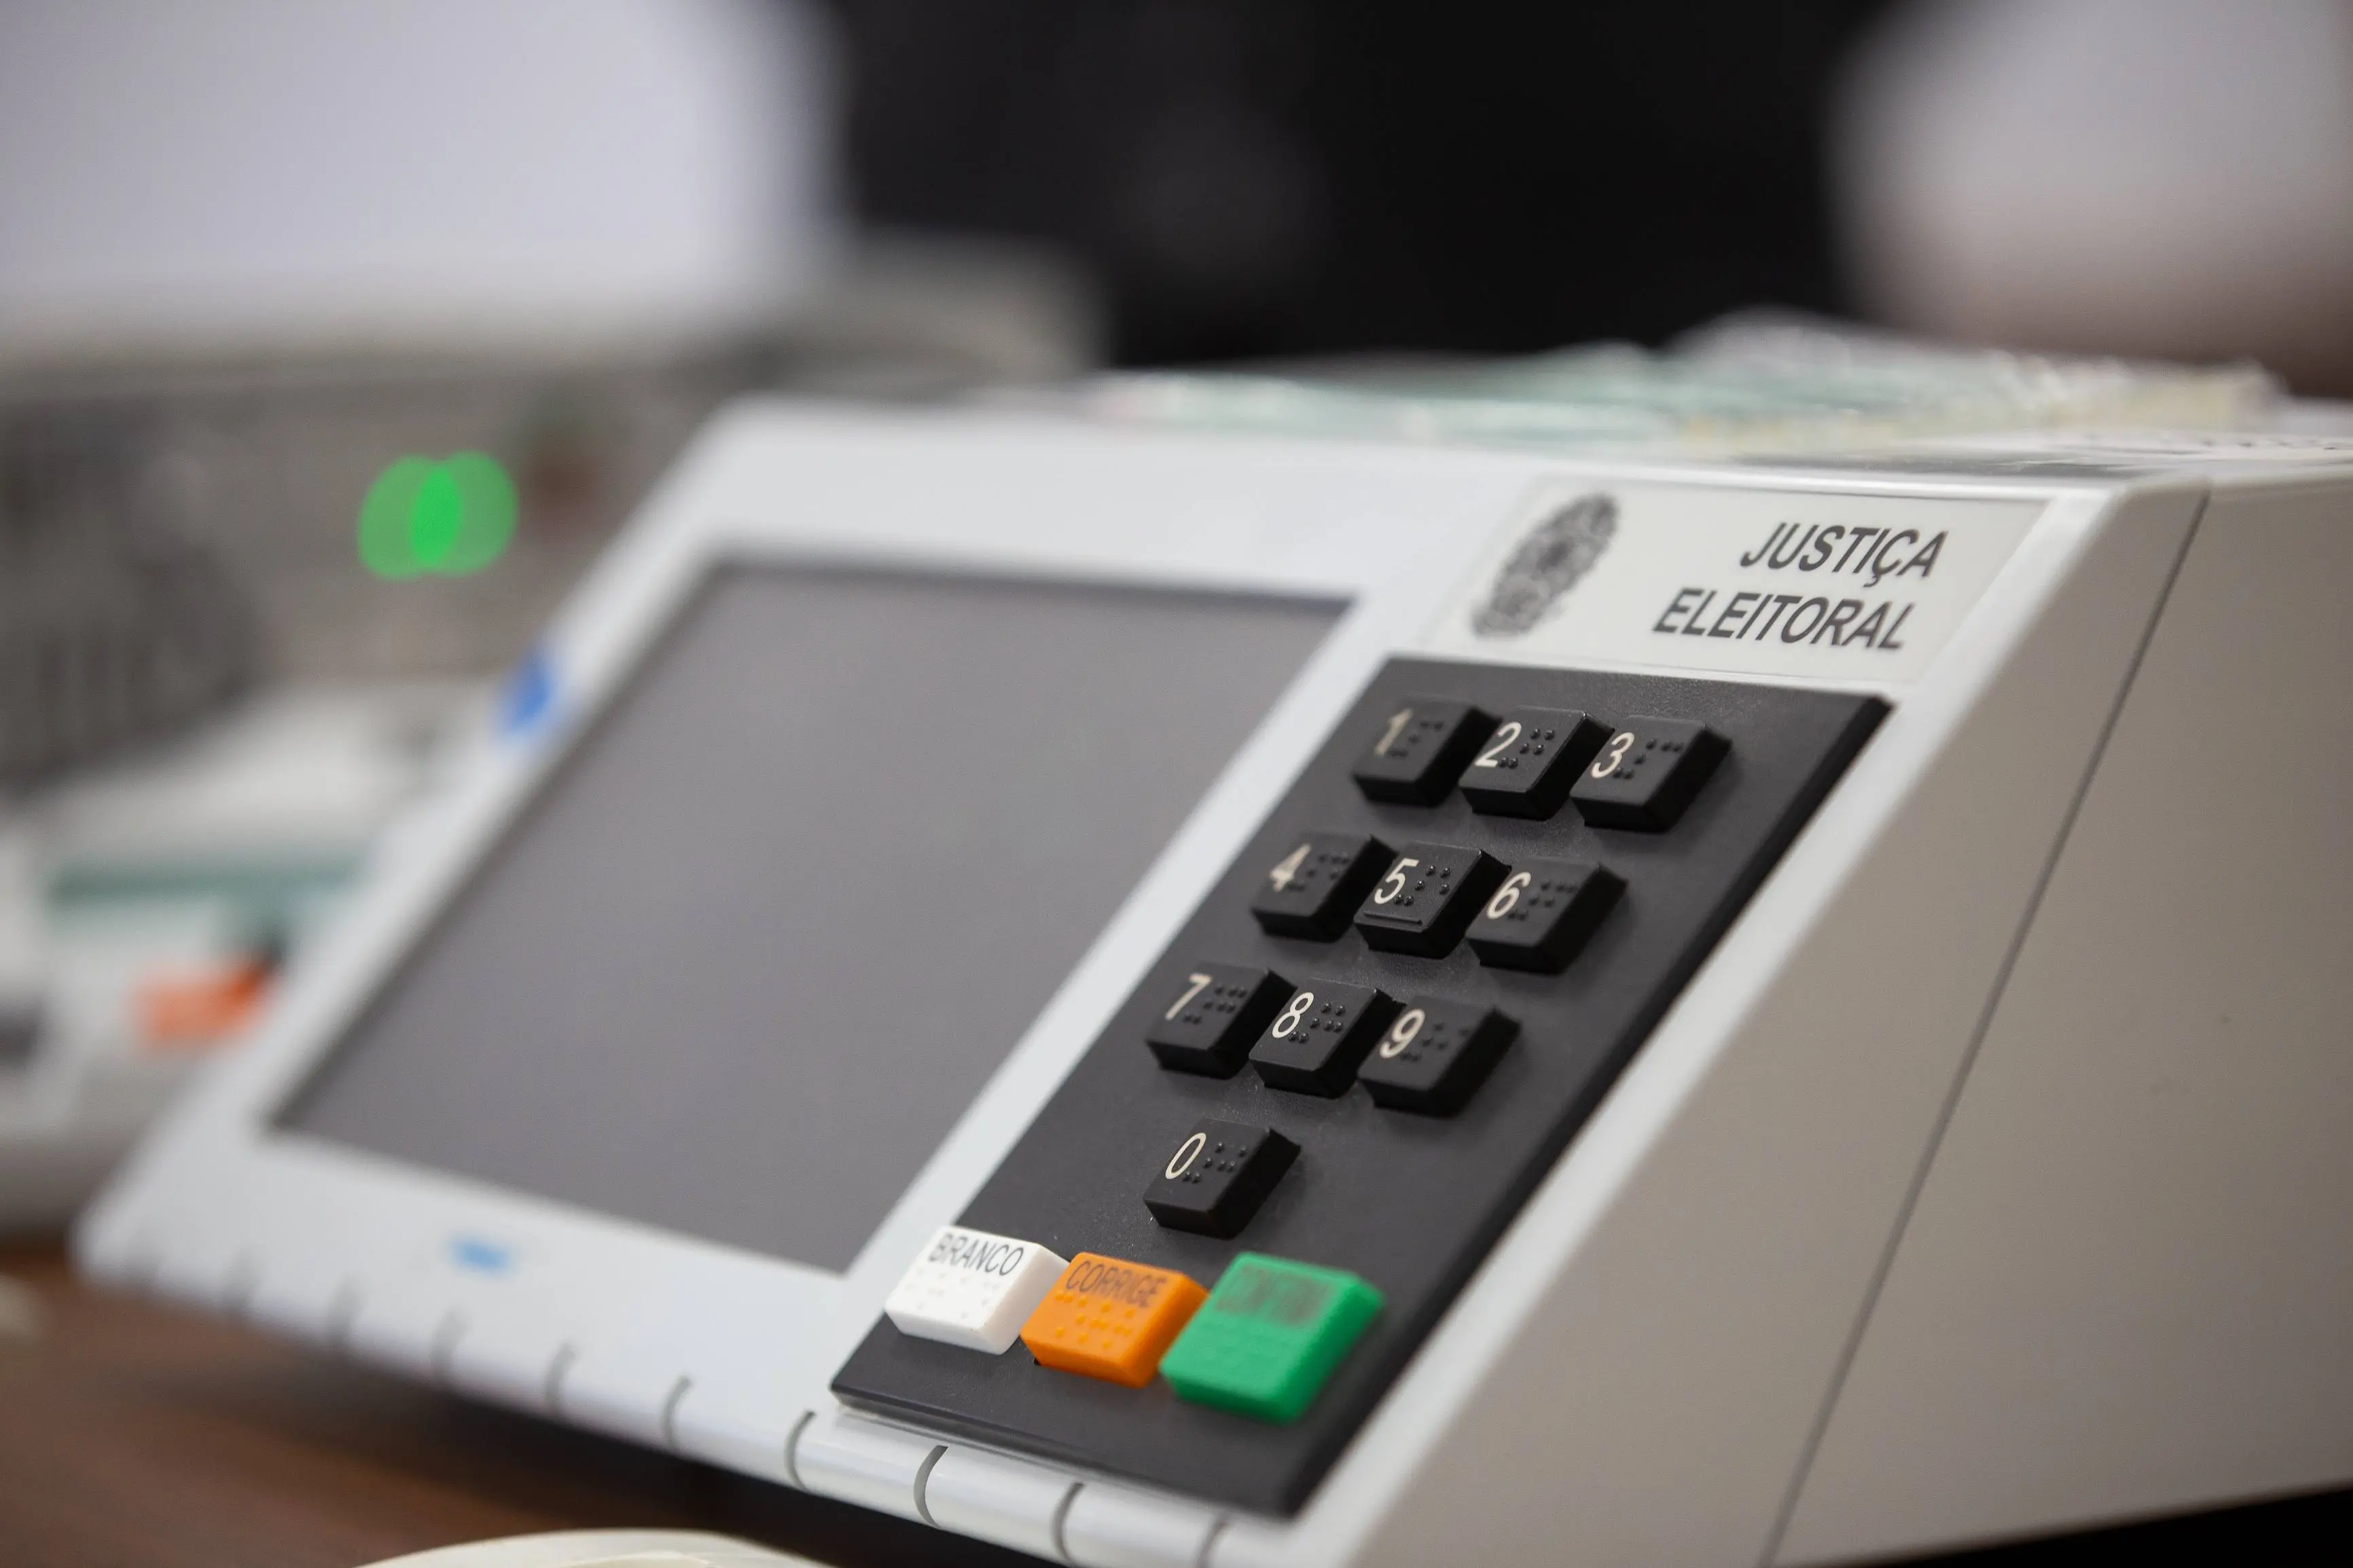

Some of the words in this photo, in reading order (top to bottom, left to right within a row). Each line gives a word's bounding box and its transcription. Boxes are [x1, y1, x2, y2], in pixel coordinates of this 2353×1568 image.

[1740, 522, 1948, 587] JUSTIÇA
[1652, 587, 1916, 649] ELEITORAL
[1375, 708, 1413, 756] 1
[1475, 722, 1522, 767] 2
[1590, 732, 1635, 778] 3
[1270, 843, 1311, 892] 4
[1373, 858, 1420, 904] 5
[1486, 872, 1532, 919] 6
[1166, 974, 1213, 1020] 7
[1272, 992, 1314, 1038] 8
[1379, 1009, 1425, 1059] 9
[1165, 1133, 1206, 1179] 0
[927, 1233, 1024, 1277] BRANCO
[1065, 1260, 1166, 1308] CORRIGE
